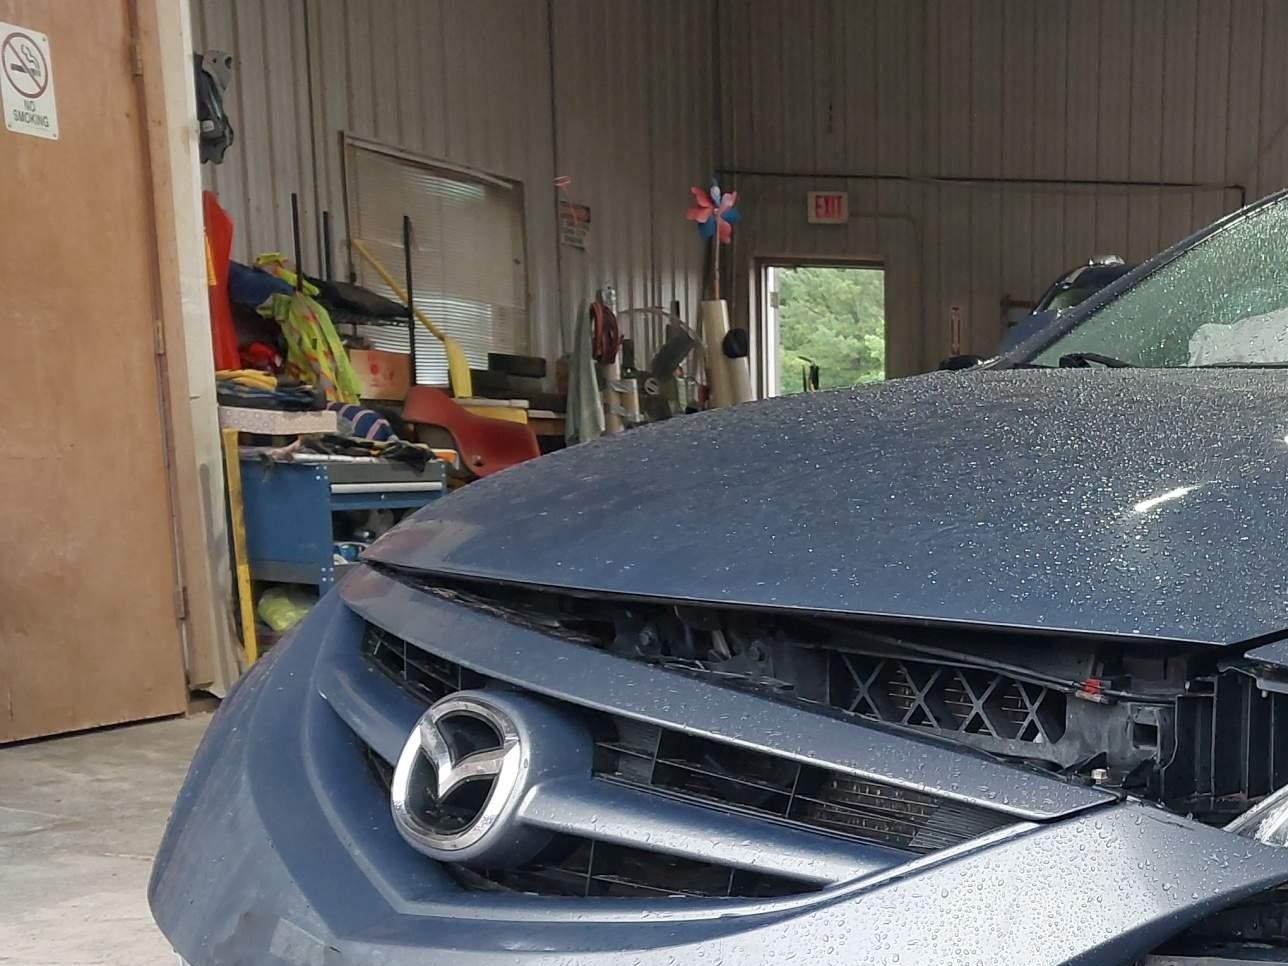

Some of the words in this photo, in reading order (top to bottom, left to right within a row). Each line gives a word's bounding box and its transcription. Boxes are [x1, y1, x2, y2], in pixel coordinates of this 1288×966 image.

[24, 100, 36, 112] NO
[13, 109, 49, 127] SMOKING
[815, 194, 843, 219] EXIT
